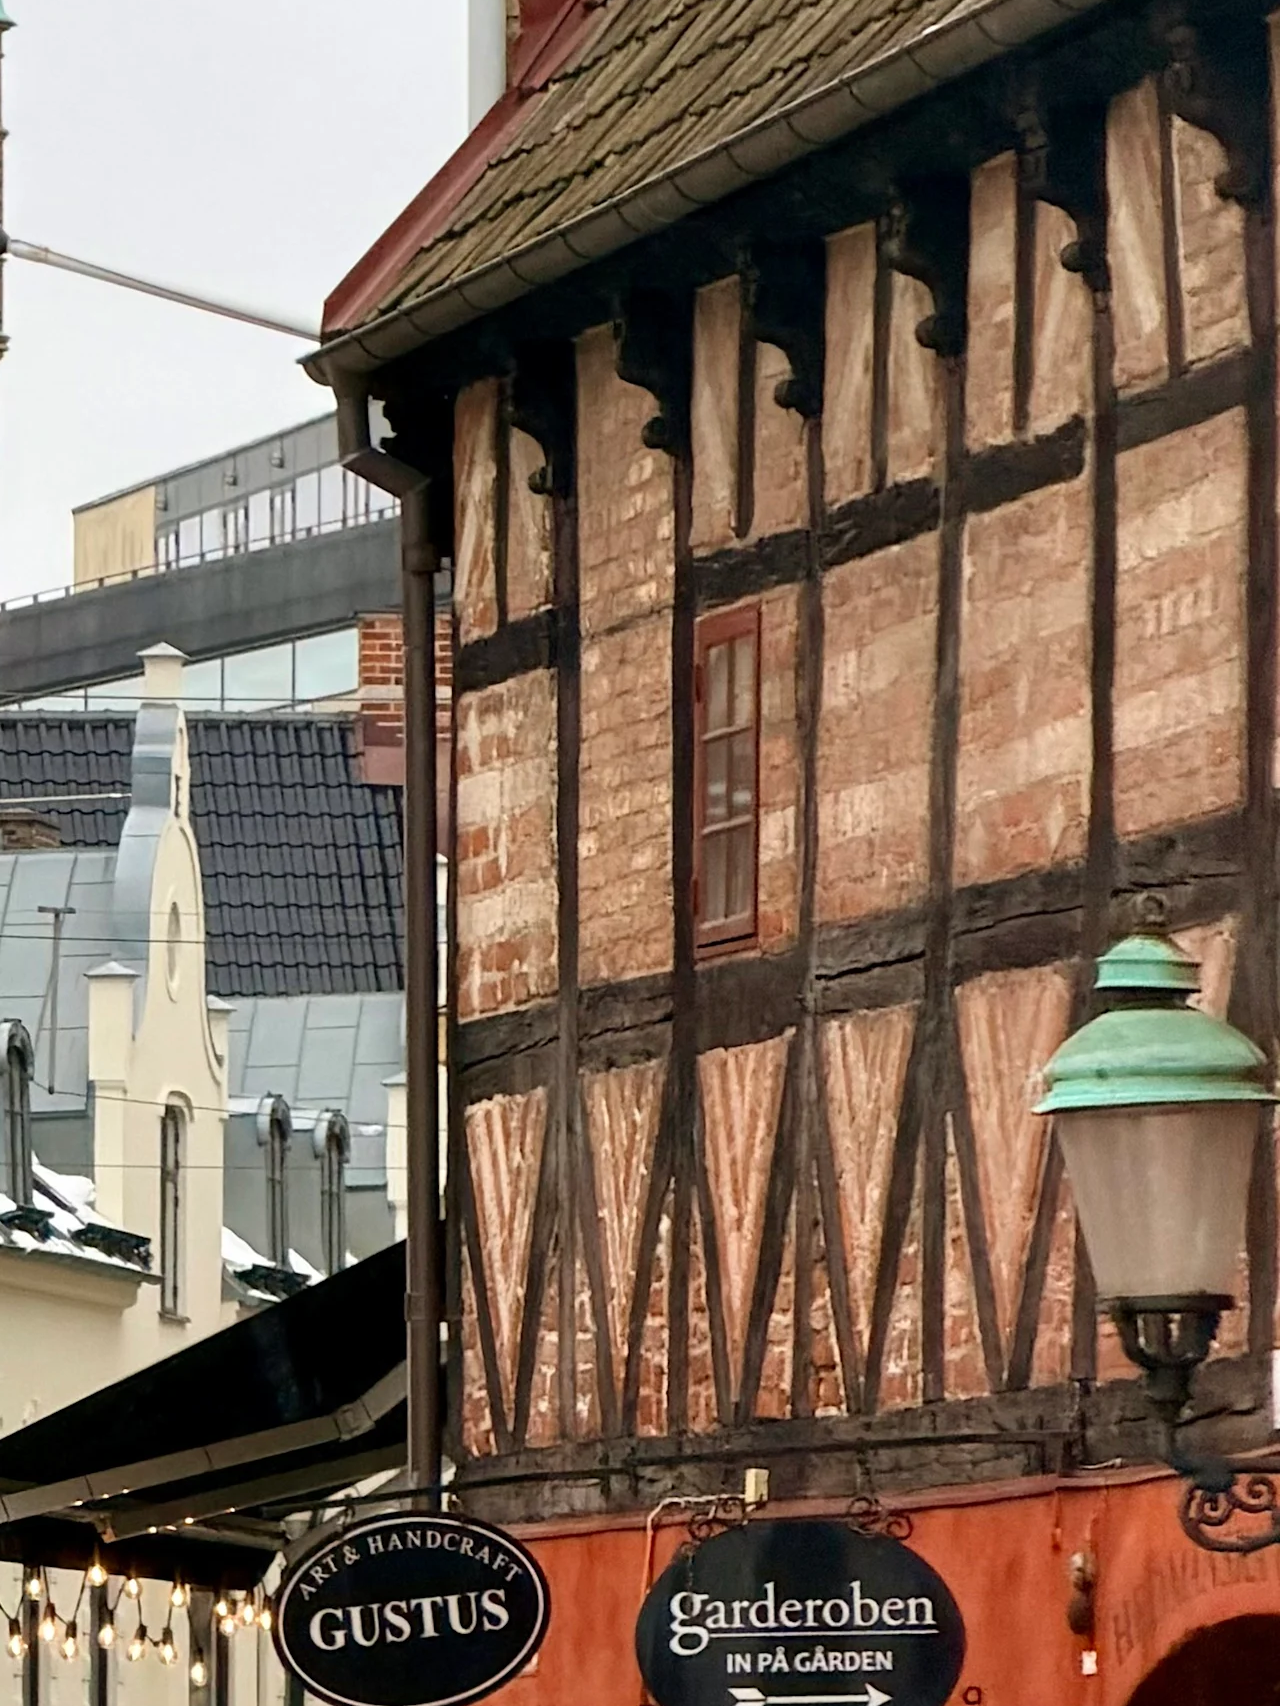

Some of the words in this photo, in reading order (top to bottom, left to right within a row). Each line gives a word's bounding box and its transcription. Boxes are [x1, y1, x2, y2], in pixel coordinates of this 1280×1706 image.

[297, 1554, 338, 1601] ART
[343, 1544, 361, 1565] &
[366, 1530, 522, 1583] HANDCRAFT
[309, 1588, 510, 1651] GUSTUS
[668, 1580, 937, 1656] garderoben
[726, 1652, 752, 1674] IN
[758, 1646, 790, 1673] PÅ
[794, 1645, 894, 1673] GÅRDEN
